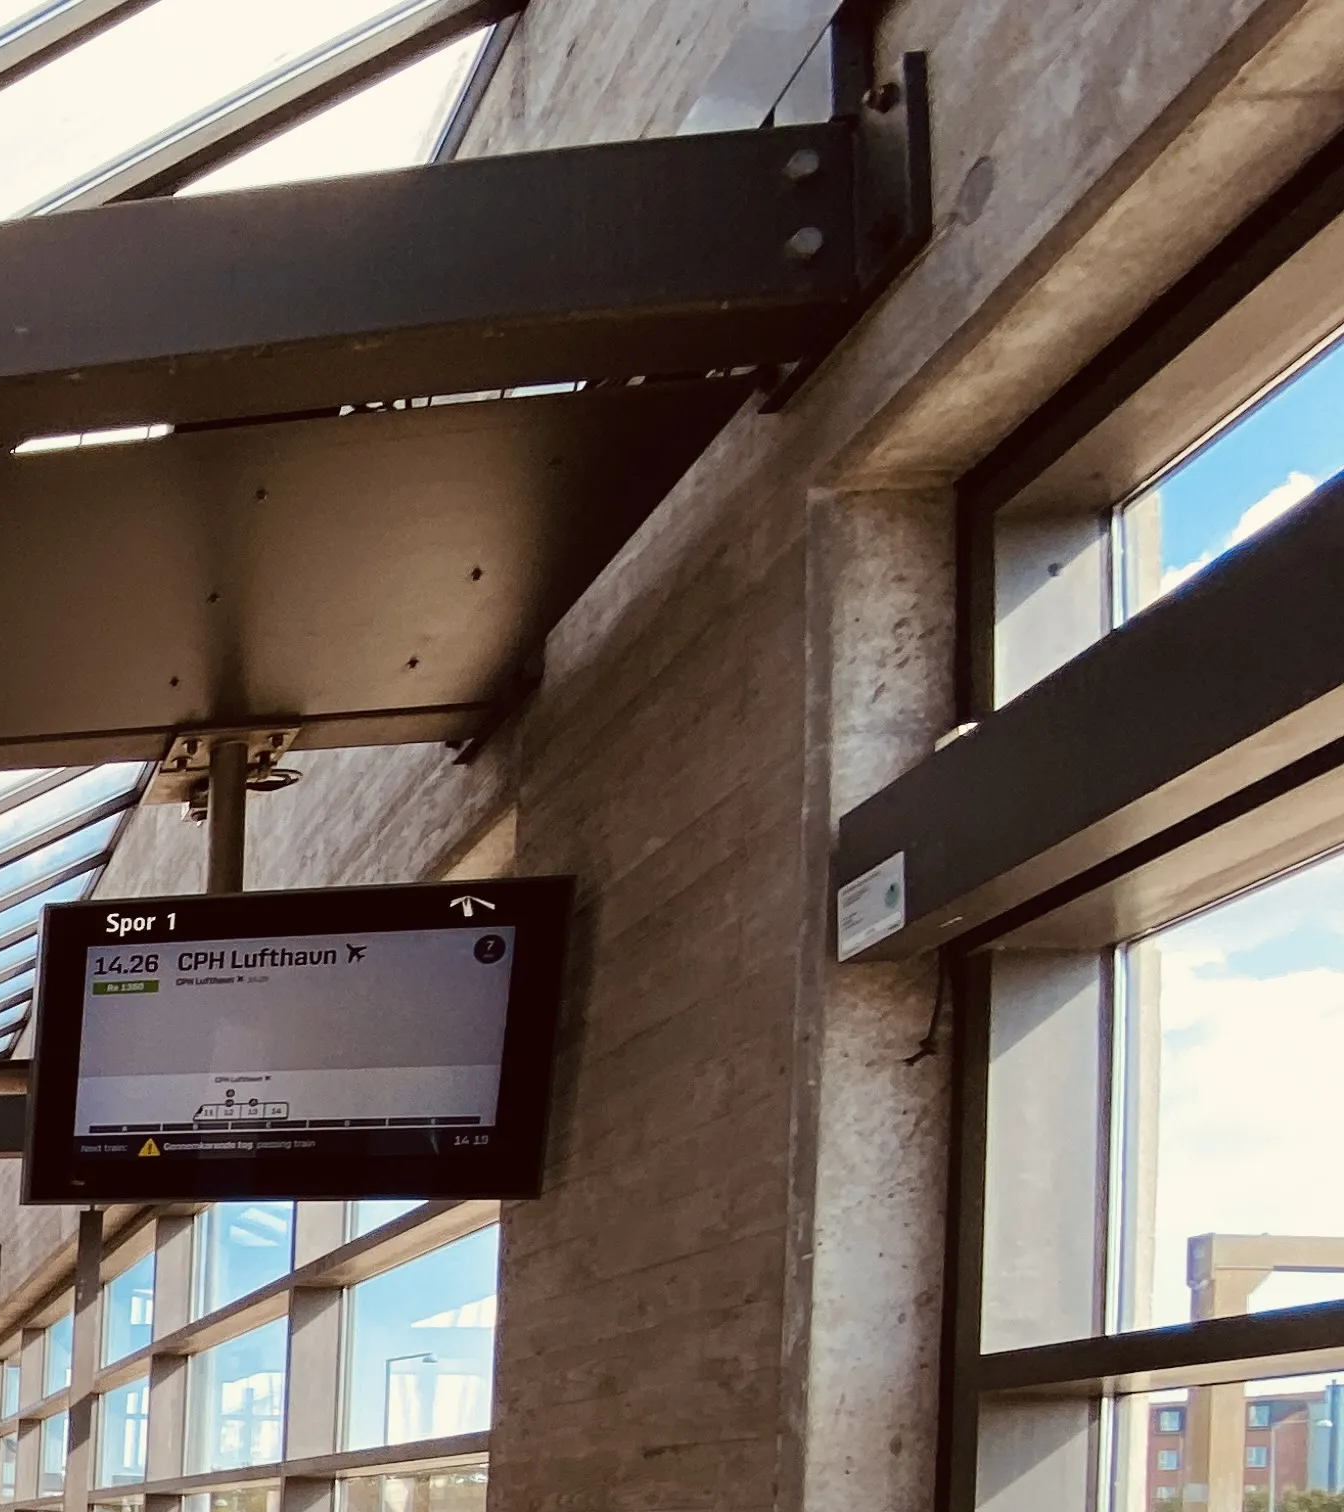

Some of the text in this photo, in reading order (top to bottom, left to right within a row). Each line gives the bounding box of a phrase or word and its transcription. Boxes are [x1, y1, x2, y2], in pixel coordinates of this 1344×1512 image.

[106, 912, 176, 936] Spor 1
[93, 948, 337, 975] 14.26 CPH Lufthavn
